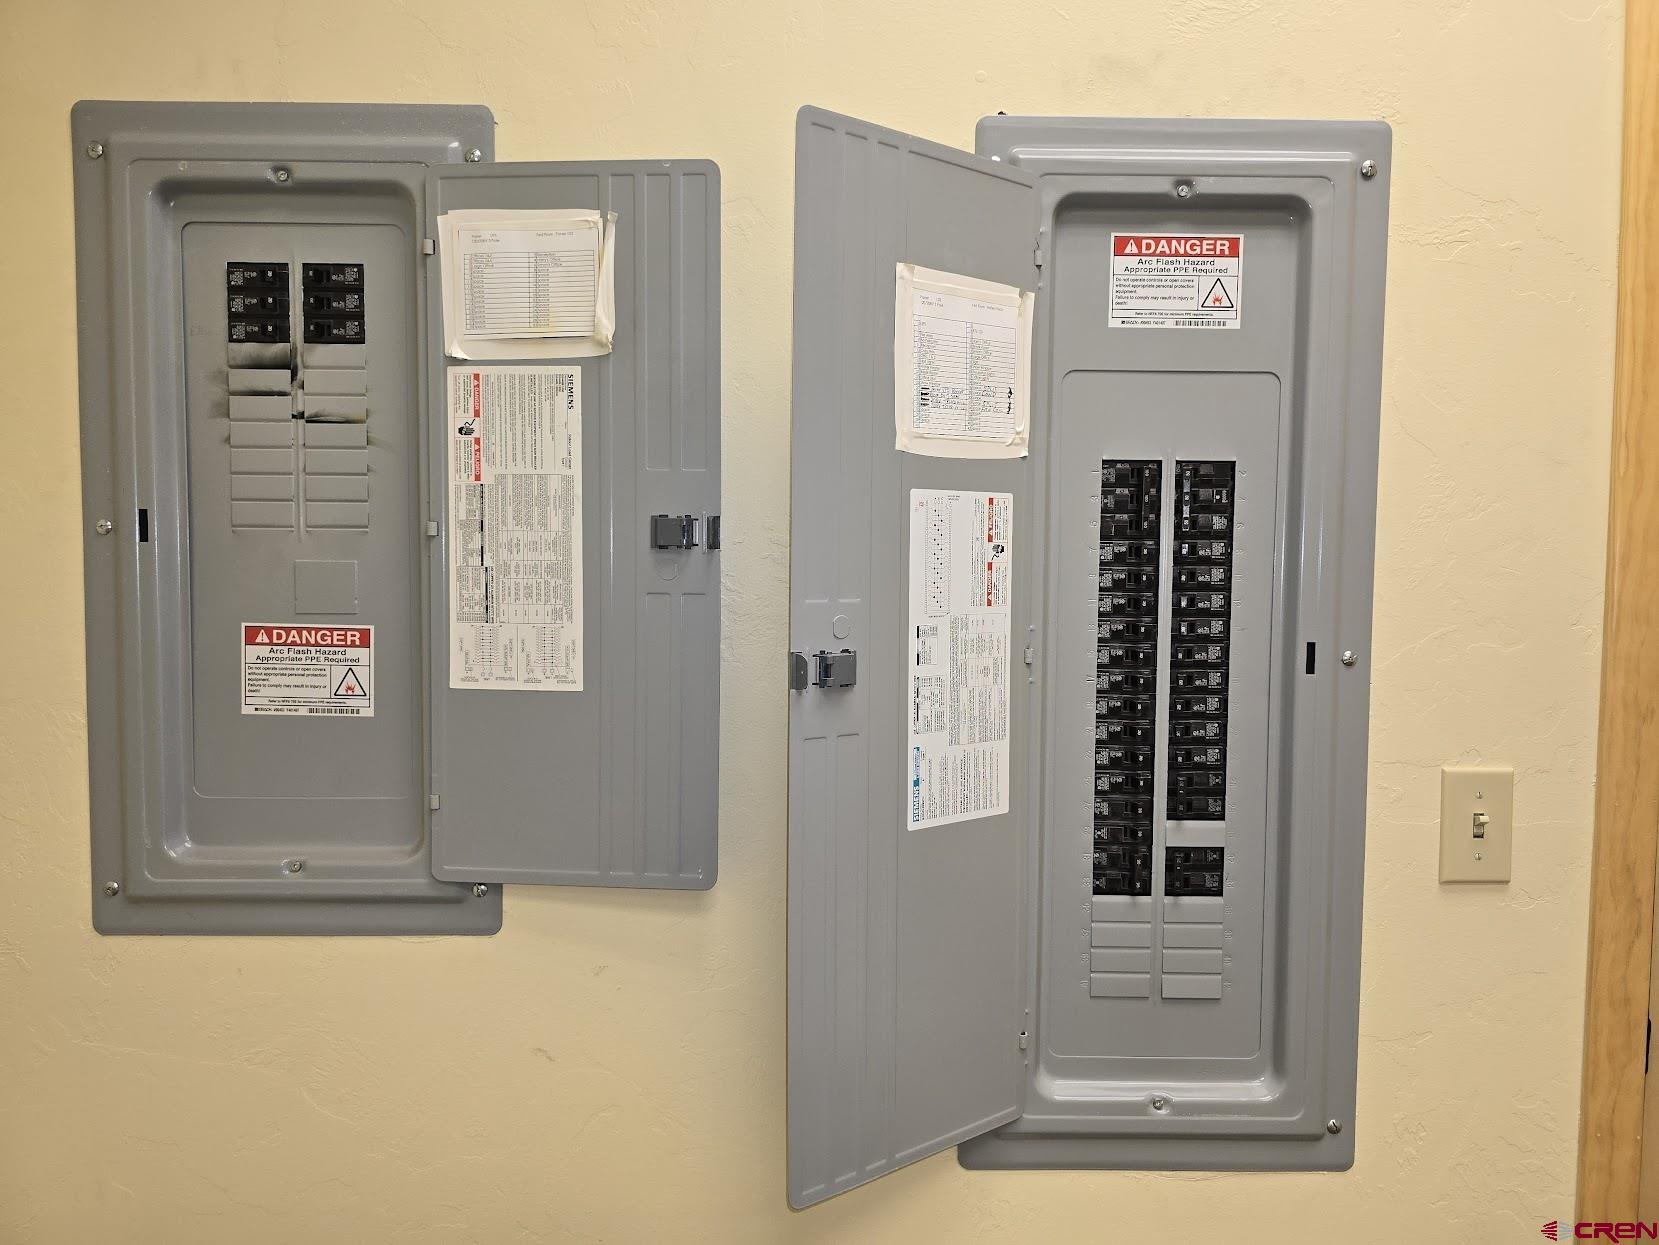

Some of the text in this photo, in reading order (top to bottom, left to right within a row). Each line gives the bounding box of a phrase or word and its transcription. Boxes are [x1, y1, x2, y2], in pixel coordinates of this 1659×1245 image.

[1142, 240, 1230, 255] DANGER
[273, 630, 360, 645] DANGER
[256, 655, 302, 663] Appropriate
